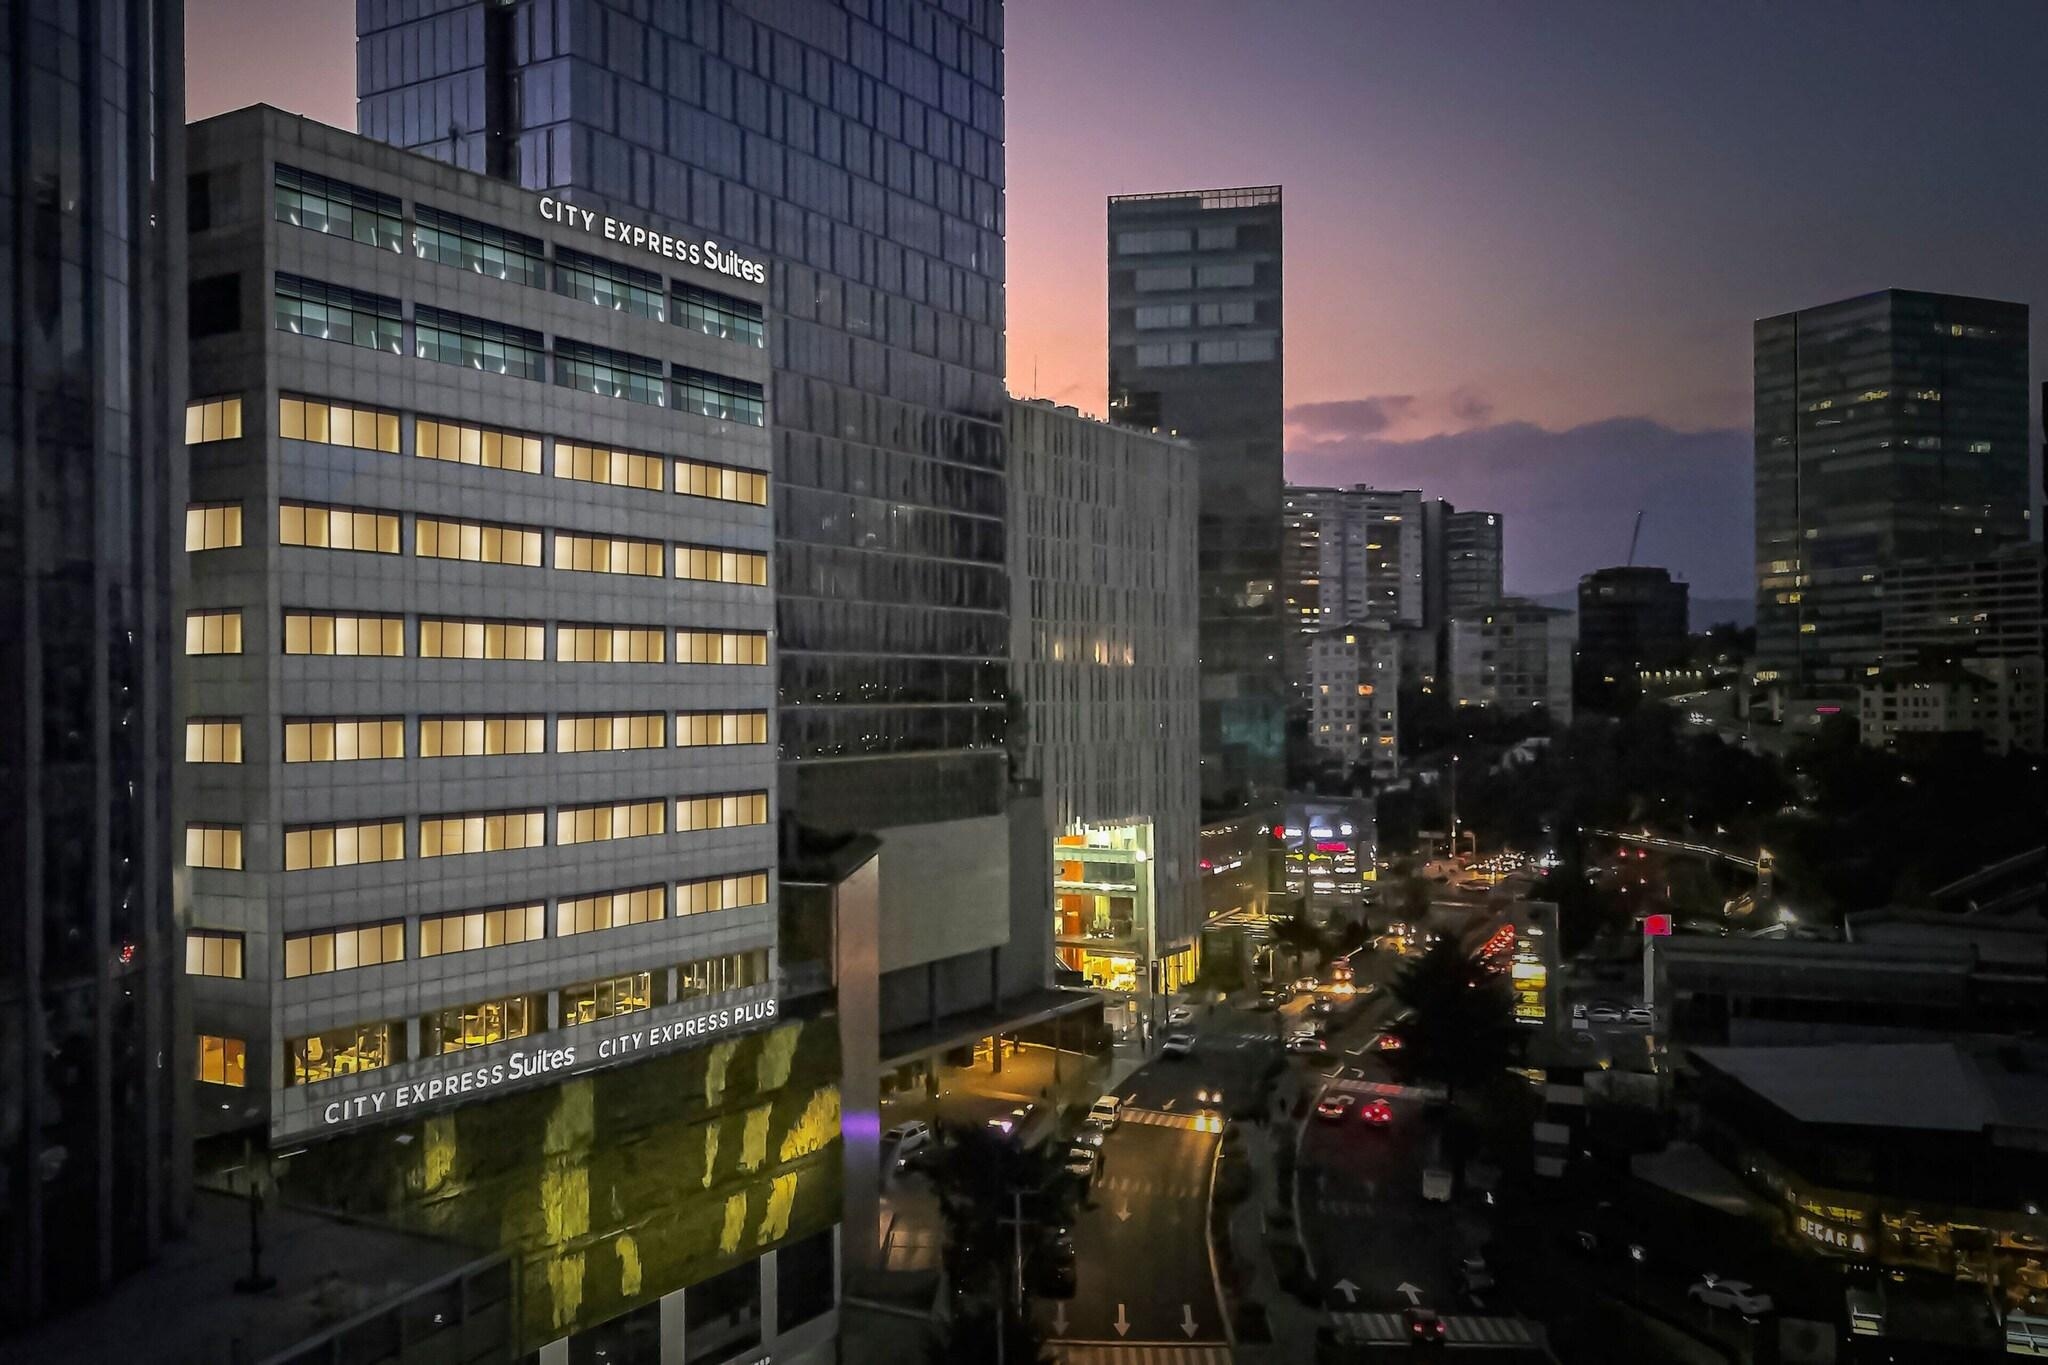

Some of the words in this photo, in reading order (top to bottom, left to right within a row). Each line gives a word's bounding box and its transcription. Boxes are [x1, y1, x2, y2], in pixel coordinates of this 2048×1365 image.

[539, 197, 595, 232] CITY
[604, 217, 700, 265] EXPRESS
[703, 241, 765, 284] Suites
[599, 1033, 641, 1059] CITY
[649, 1012, 729, 1047] EXPRESS
[734, 1000, 776, 1024] PLUS
[324, 1091, 386, 1124] CITY
[396, 1065, 504, 1109] EXPRESS
[508, 1046, 576, 1081] Suites
